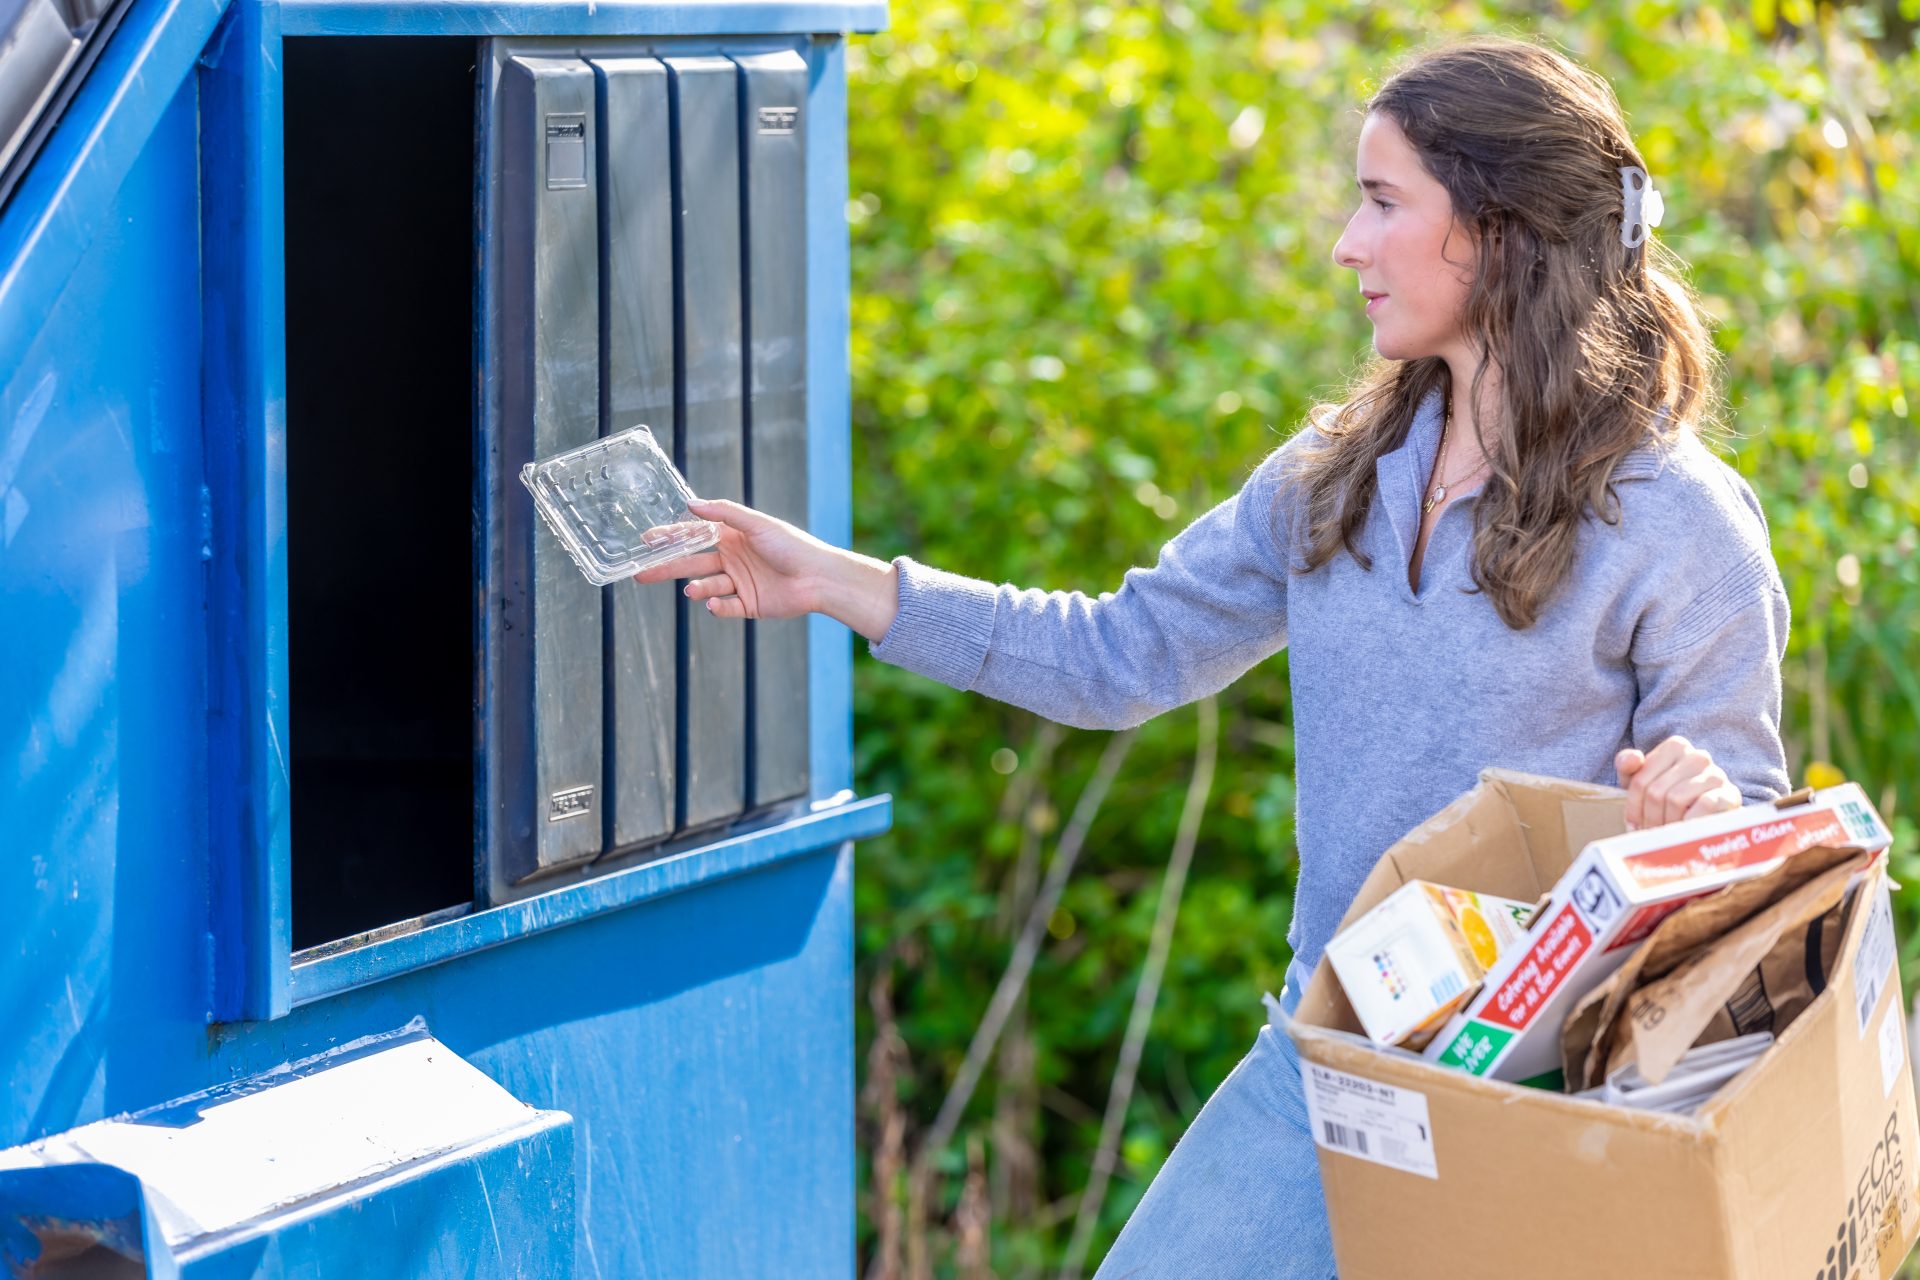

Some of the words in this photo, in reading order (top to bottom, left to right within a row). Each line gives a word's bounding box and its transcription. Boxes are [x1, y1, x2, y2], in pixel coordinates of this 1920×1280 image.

[1751, 820, 1796, 844] Chicken
[1498, 958, 1539, 1011] Catering
[1535, 914, 1576, 965] Available
[1509, 1003, 1526, 1024] For
[1524, 986, 1539, 1008] All
[1451, 1031, 1474, 1060] WE
[1857, 1111, 1900, 1221] ECR
